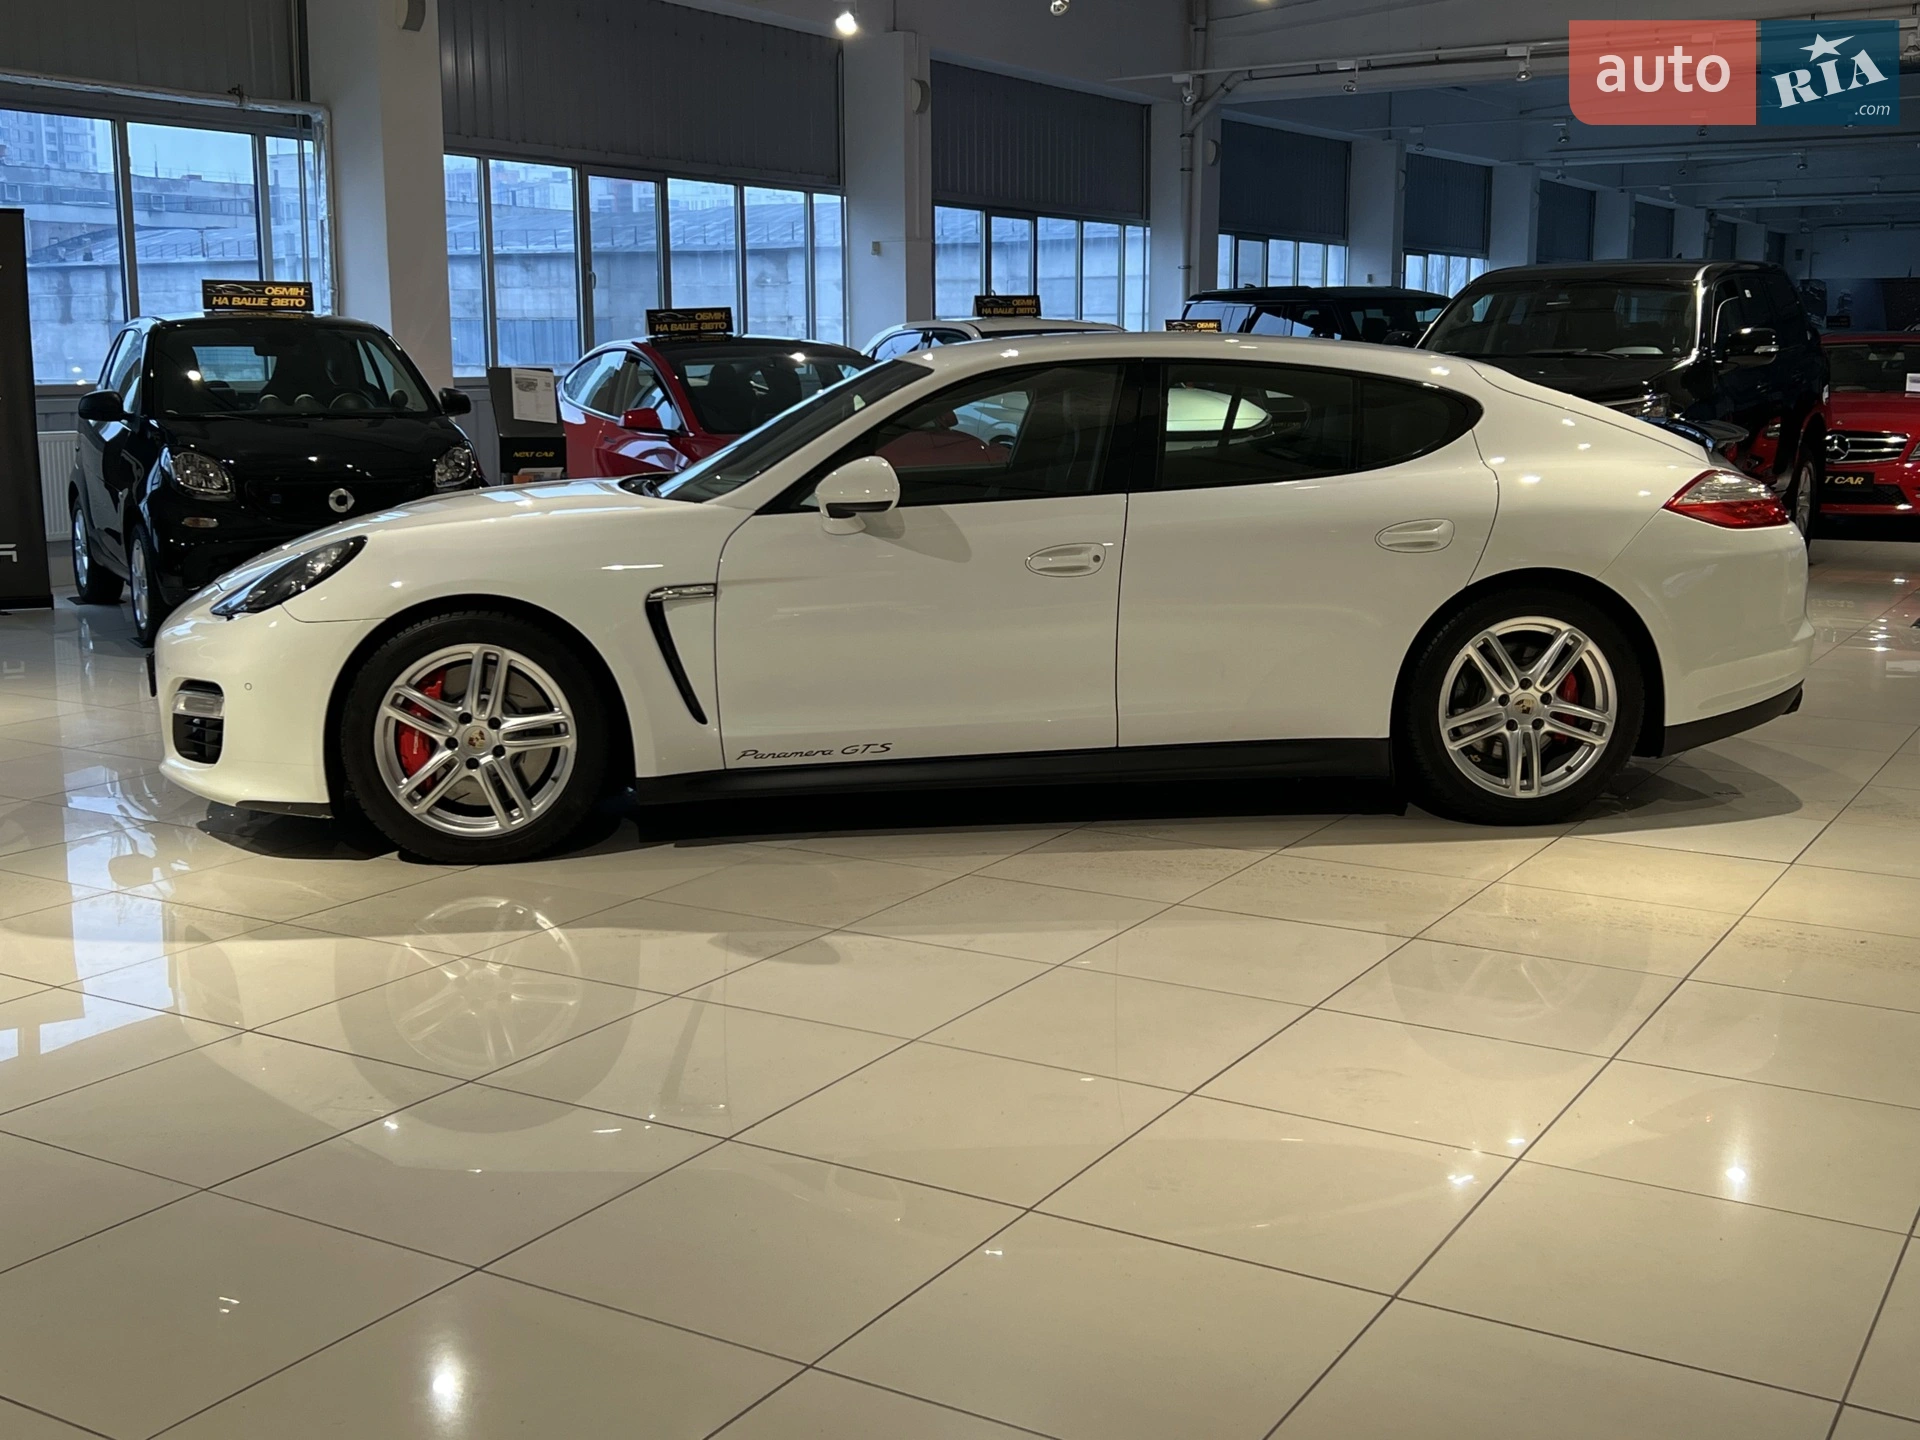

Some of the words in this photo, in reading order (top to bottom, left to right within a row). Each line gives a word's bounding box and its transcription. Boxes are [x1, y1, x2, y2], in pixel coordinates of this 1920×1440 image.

[265, 286, 305, 296] ОБМІН
[212, 296, 229, 306] НА
[231, 297, 269, 306] ВАШЕ
[655, 324, 669, 332] НА
[670, 322, 699, 331] ВАШЕ
[1834, 476, 1865, 485] CAR
[736, 749, 834, 761] Panamera
[841, 742, 893, 755] GTS
